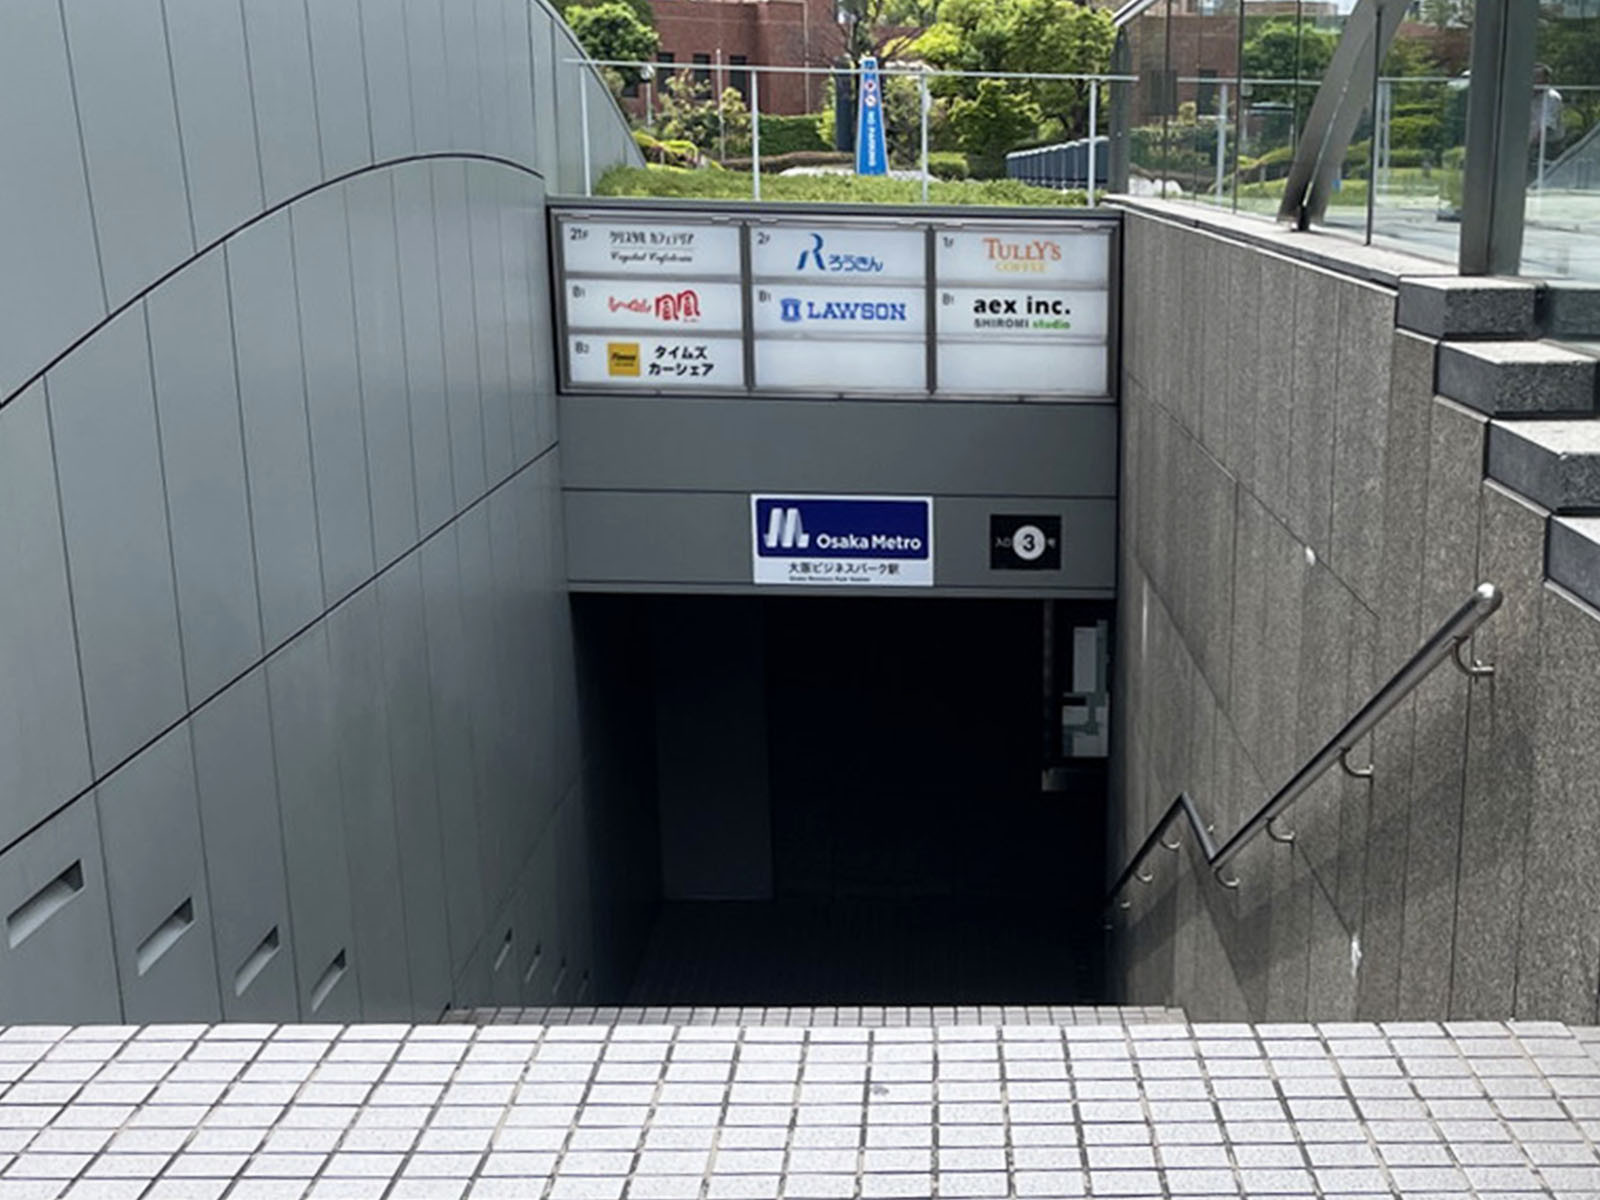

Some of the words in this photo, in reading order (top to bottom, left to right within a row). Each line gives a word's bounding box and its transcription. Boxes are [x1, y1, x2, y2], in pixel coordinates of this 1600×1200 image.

[828, 254, 883, 272] ろうきん
[807, 302, 907, 321] LAWSON
[973, 299, 1017, 315] aex
[1026, 296, 1071, 315] inc.
[974, 318, 1029, 328] SHIROMI
[1032, 319, 1071, 329] studio
[655, 345, 708, 360] タイムズ
[648, 363, 714, 377] カーシェア
[816, 533, 868, 549] Osaka
[871, 535, 922, 550] Metro
